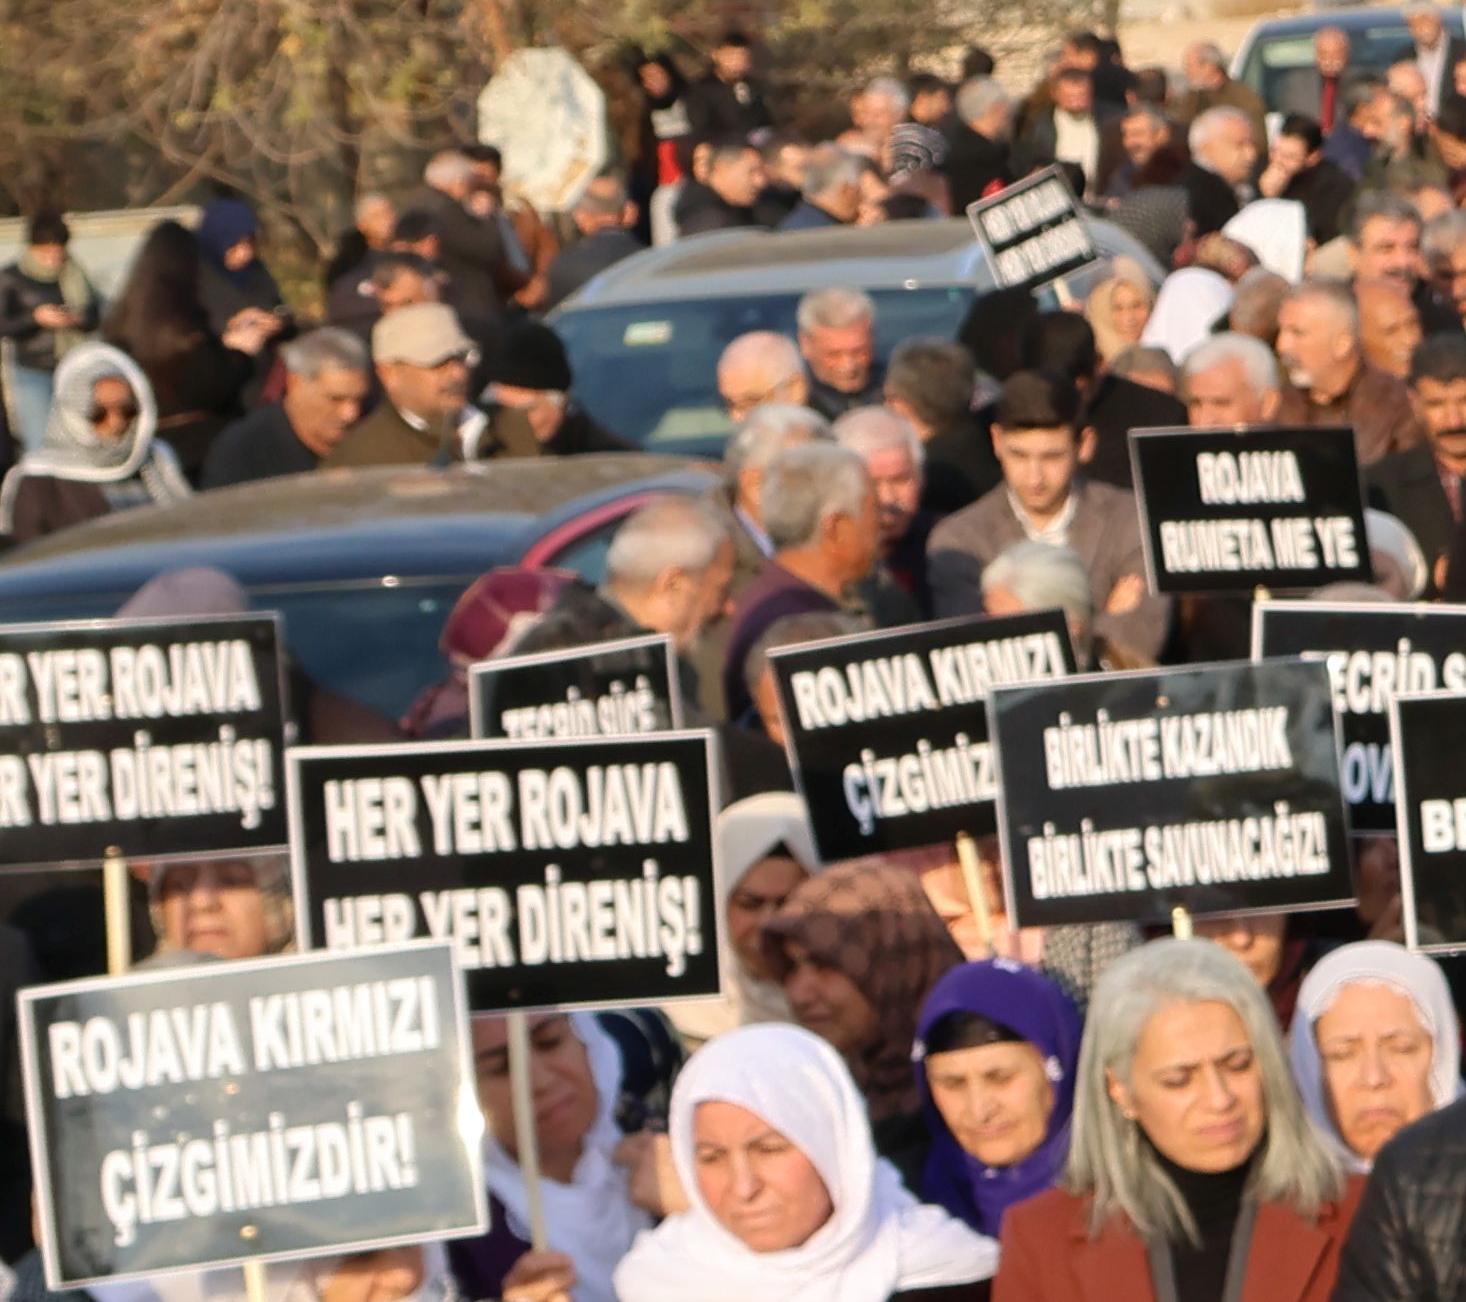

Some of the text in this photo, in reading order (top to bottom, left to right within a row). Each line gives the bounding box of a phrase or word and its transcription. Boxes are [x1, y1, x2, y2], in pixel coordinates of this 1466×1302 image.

[1196, 451, 1305, 504] ROJAVA
[1313, 515, 1357, 570] YE
[29, 647, 107, 719] YER
[111, 637, 262, 714] ROJAVA
[791, 632, 1067, 731] ROJAVA KIRMIZI
[29, 749, 107, 824] YER
[111, 731, 275, 830] DİRENİŞ!
[1043, 707, 1160, 791] BİRLİKTE
[1159, 705, 1293, 780] KAZANDIK
[323, 761, 689, 862] HER YER ROJAVA
[1026, 801, 1329, 900] BİRLİKTE SAVUNACAĞIZ!
[424, 886, 518, 971] YER
[522, 860, 704, 979] DİRENİŞ!
[47, 975, 439, 1099] ROJAVA KIRMIZI
[99, 1113, 419, 1248] ÇİZGİMİZDİR!
